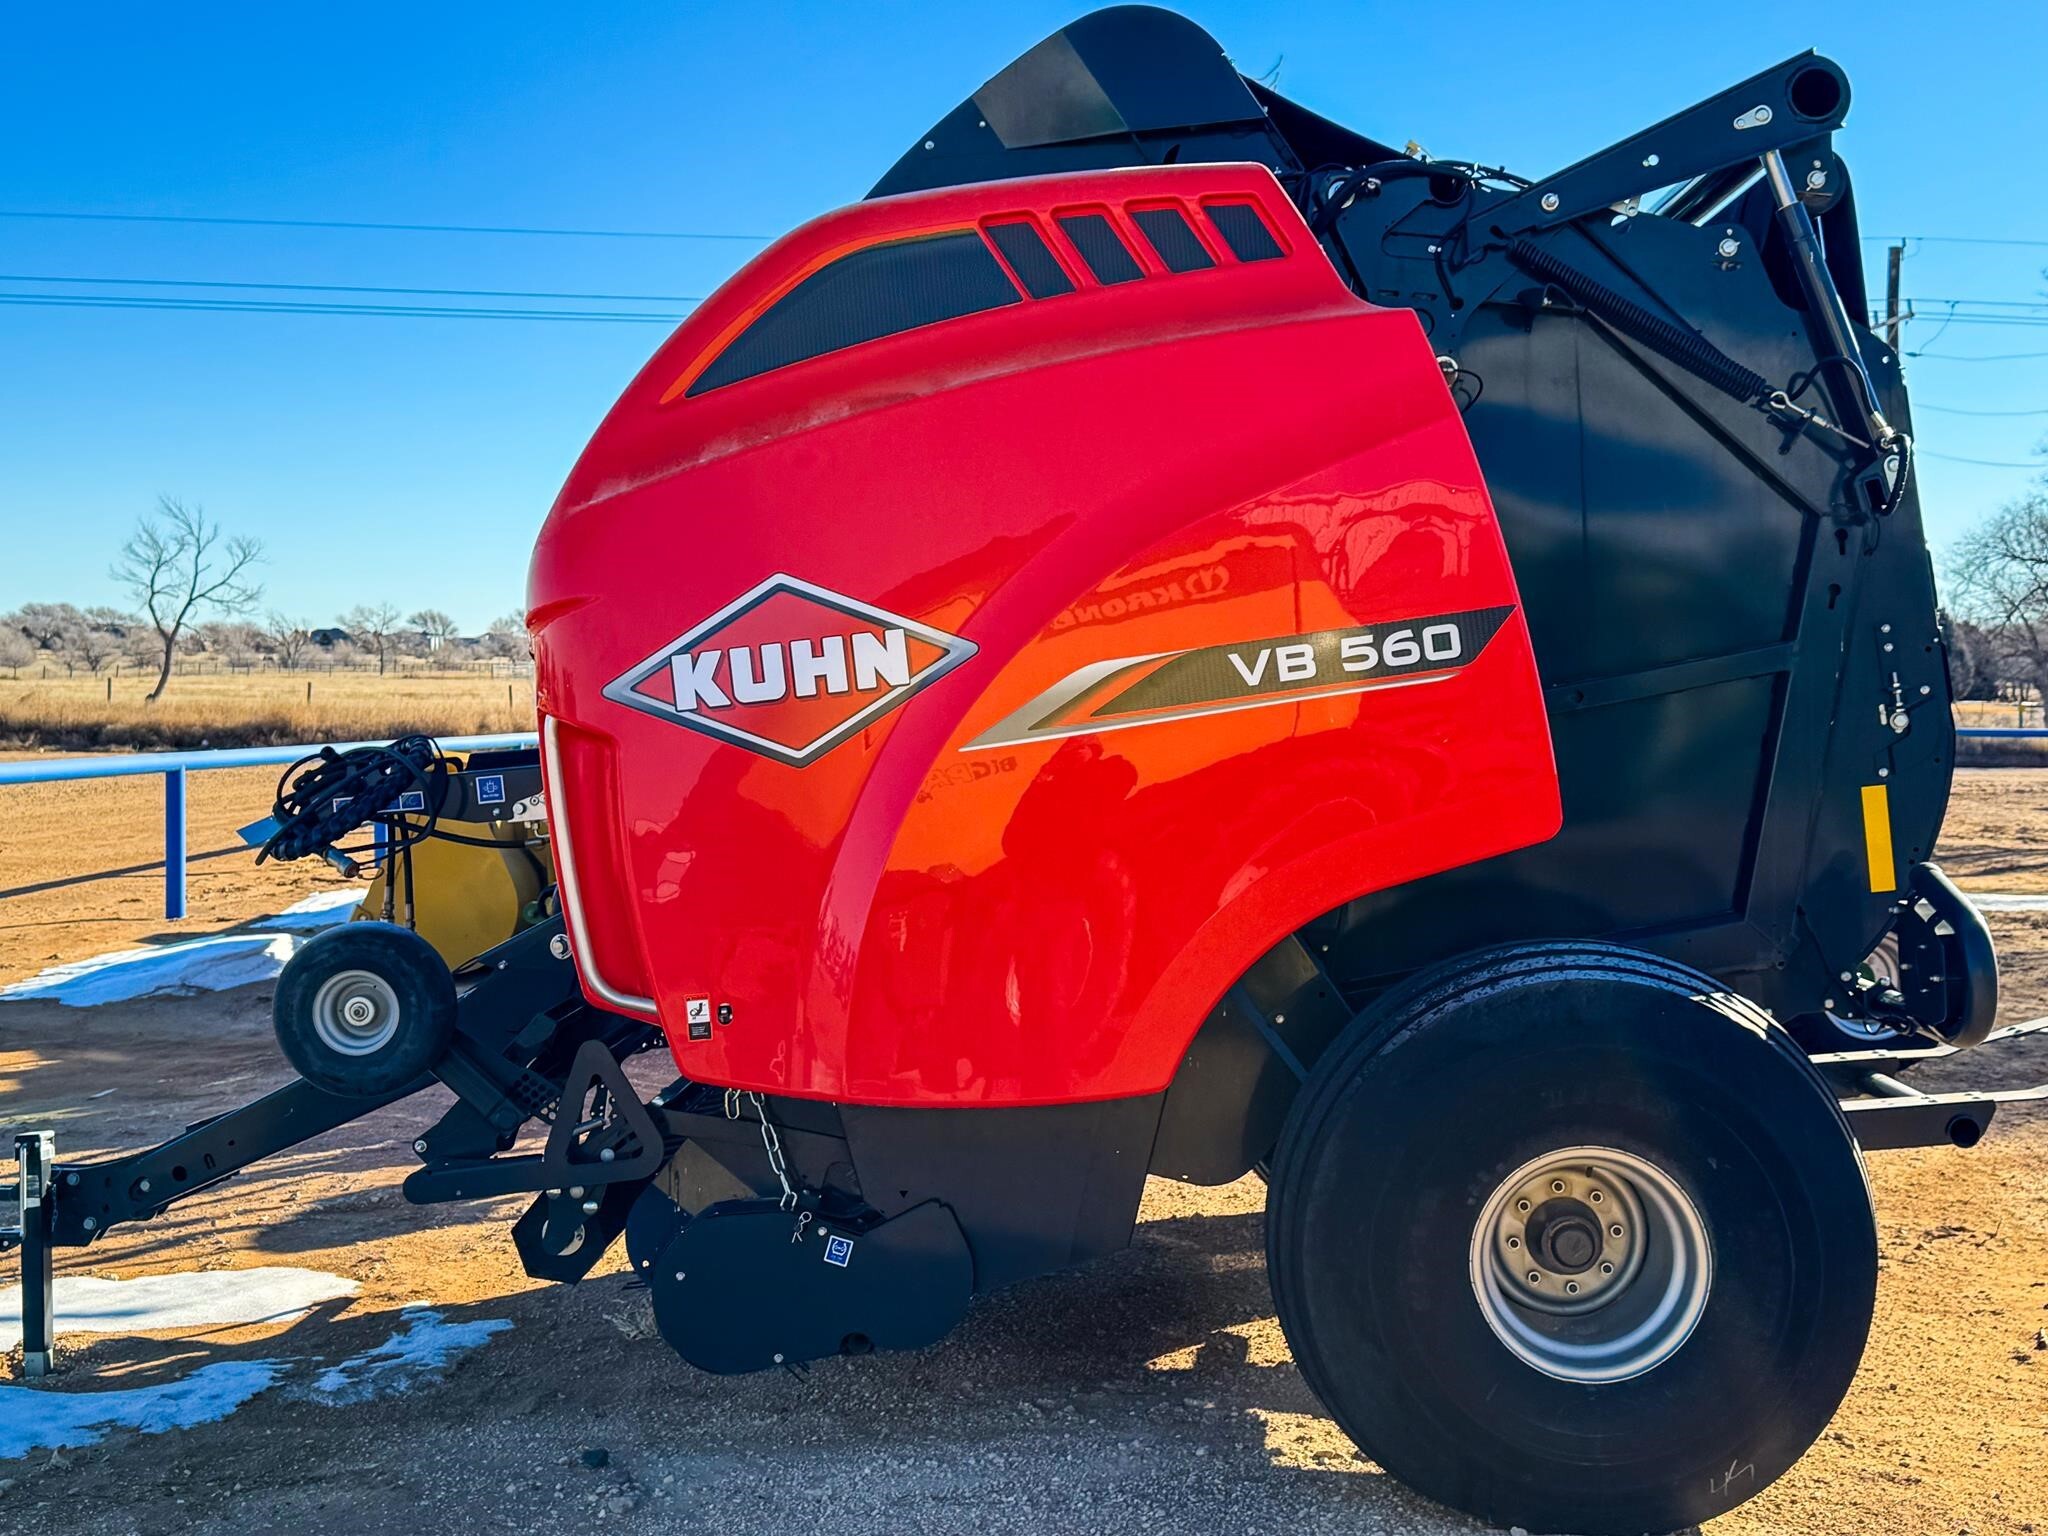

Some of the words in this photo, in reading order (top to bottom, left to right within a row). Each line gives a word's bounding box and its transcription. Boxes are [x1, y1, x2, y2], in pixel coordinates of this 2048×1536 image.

[670, 628, 911, 711] KUHN
[1227, 644, 1317, 686] VB
[1341, 623, 1461, 672] 560
